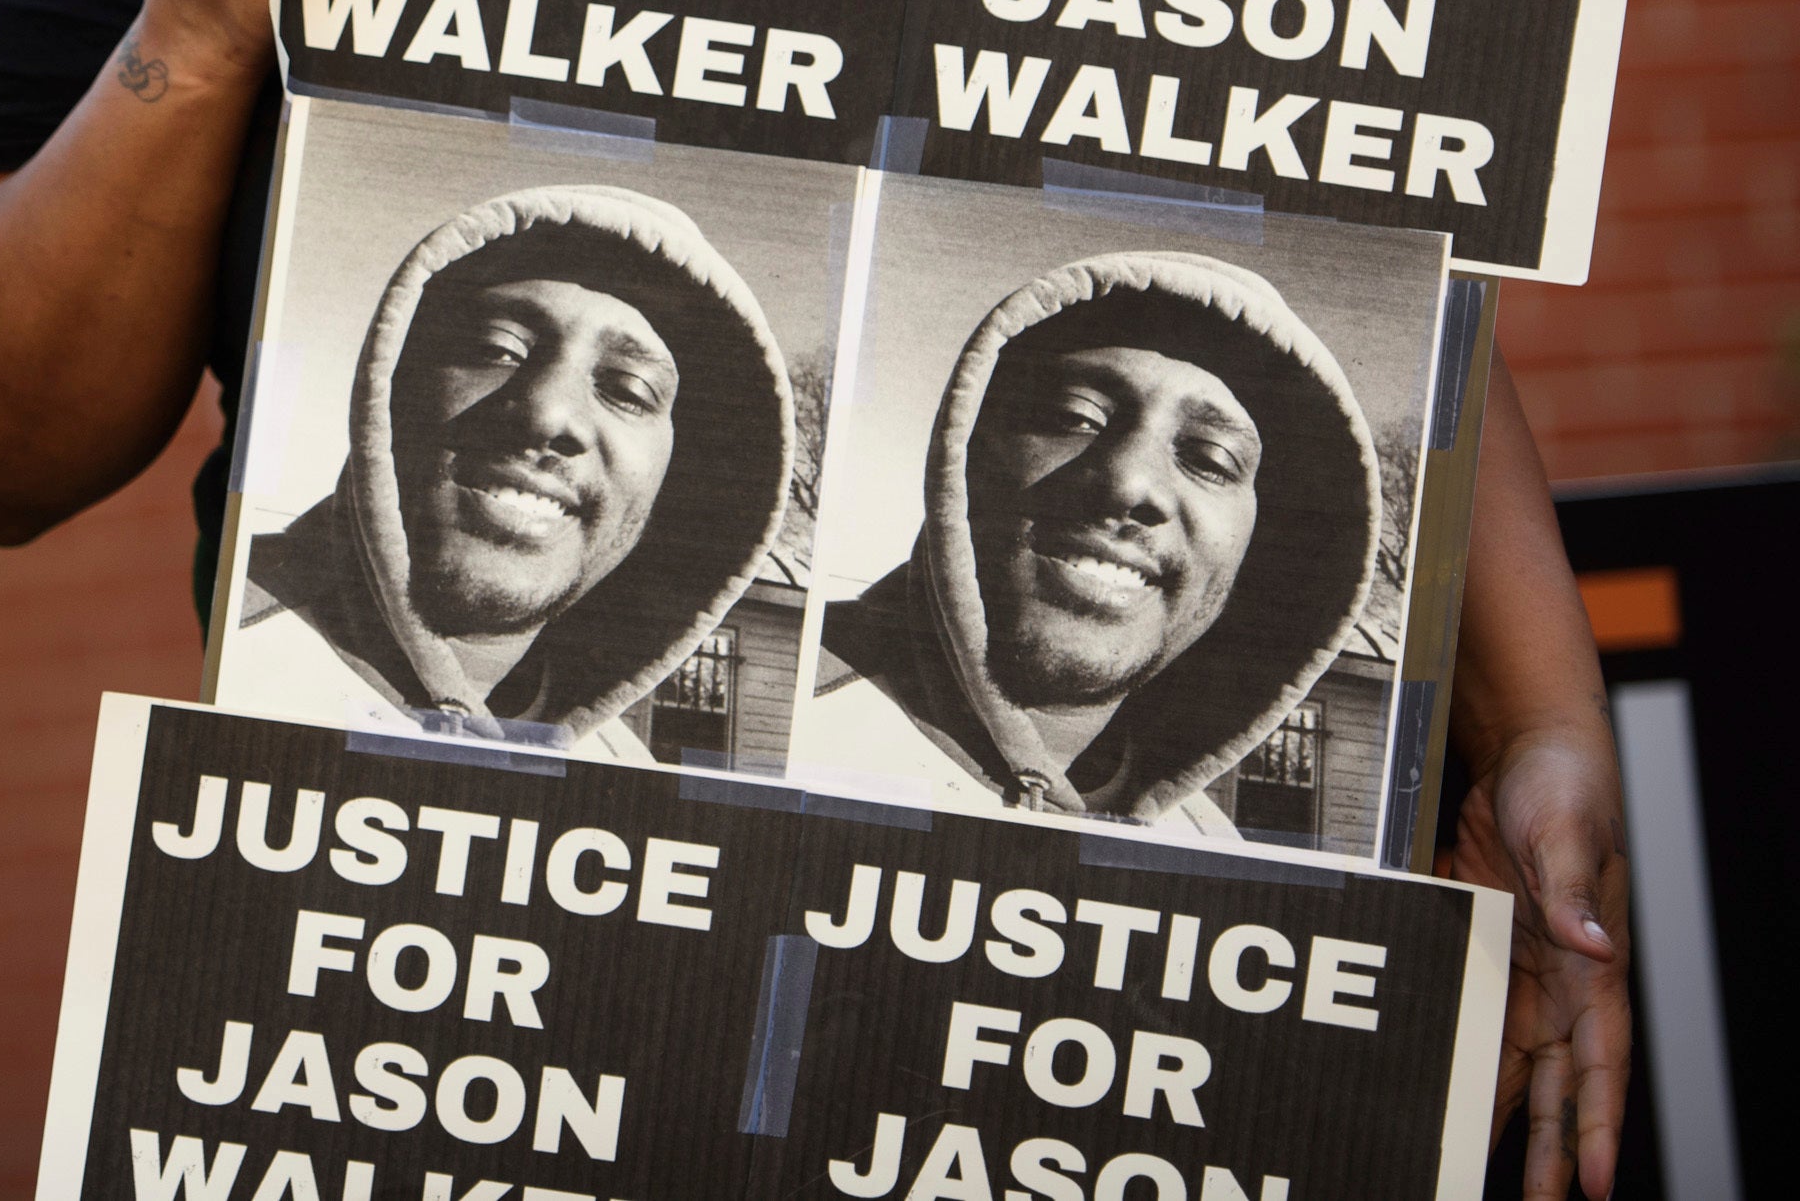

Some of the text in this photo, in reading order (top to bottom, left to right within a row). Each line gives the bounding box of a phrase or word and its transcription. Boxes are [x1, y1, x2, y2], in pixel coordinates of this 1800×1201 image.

[933, 43, 1495, 207] WALKER
[152, 774, 721, 931] JUSTICE
[287, 908, 550, 1030] FOR
[804, 862, 1388, 1031] JUSTICE
[176, 1019, 626, 1162] JASON
[941, 1000, 1212, 1128] FOR
